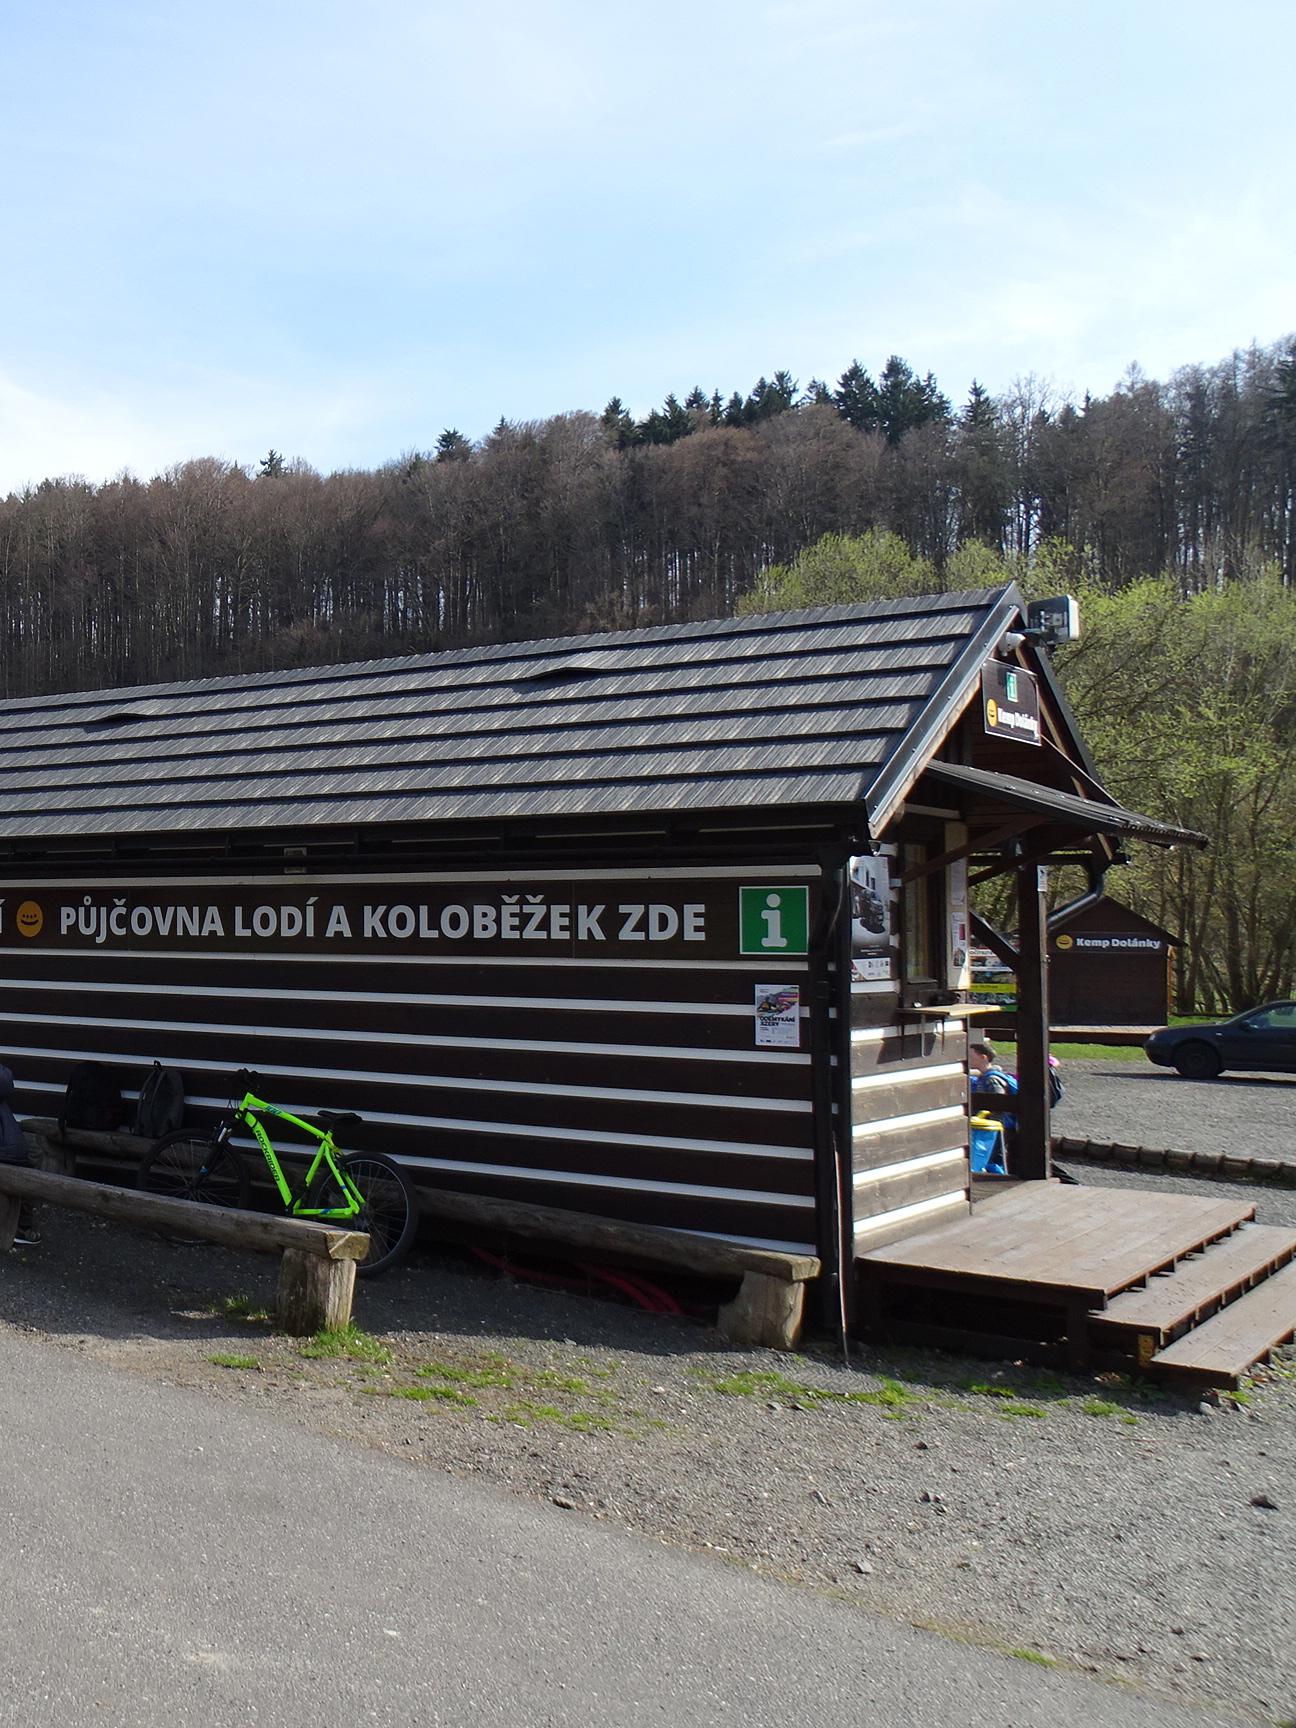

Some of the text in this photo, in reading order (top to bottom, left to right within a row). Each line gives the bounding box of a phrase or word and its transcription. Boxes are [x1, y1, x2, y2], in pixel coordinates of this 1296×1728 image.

[60, 895, 224, 944] PŮJČOVNA
[234, 896, 318, 937] LODÍ
[325, 906, 352, 937] A
[363, 894, 606, 941] KOLOBĚŽEK
[618, 904, 706, 941] ZDE
[1076, 938, 1160, 949] Kemp Dolánky
[255, 1129, 281, 1182] ROCKRIDER
